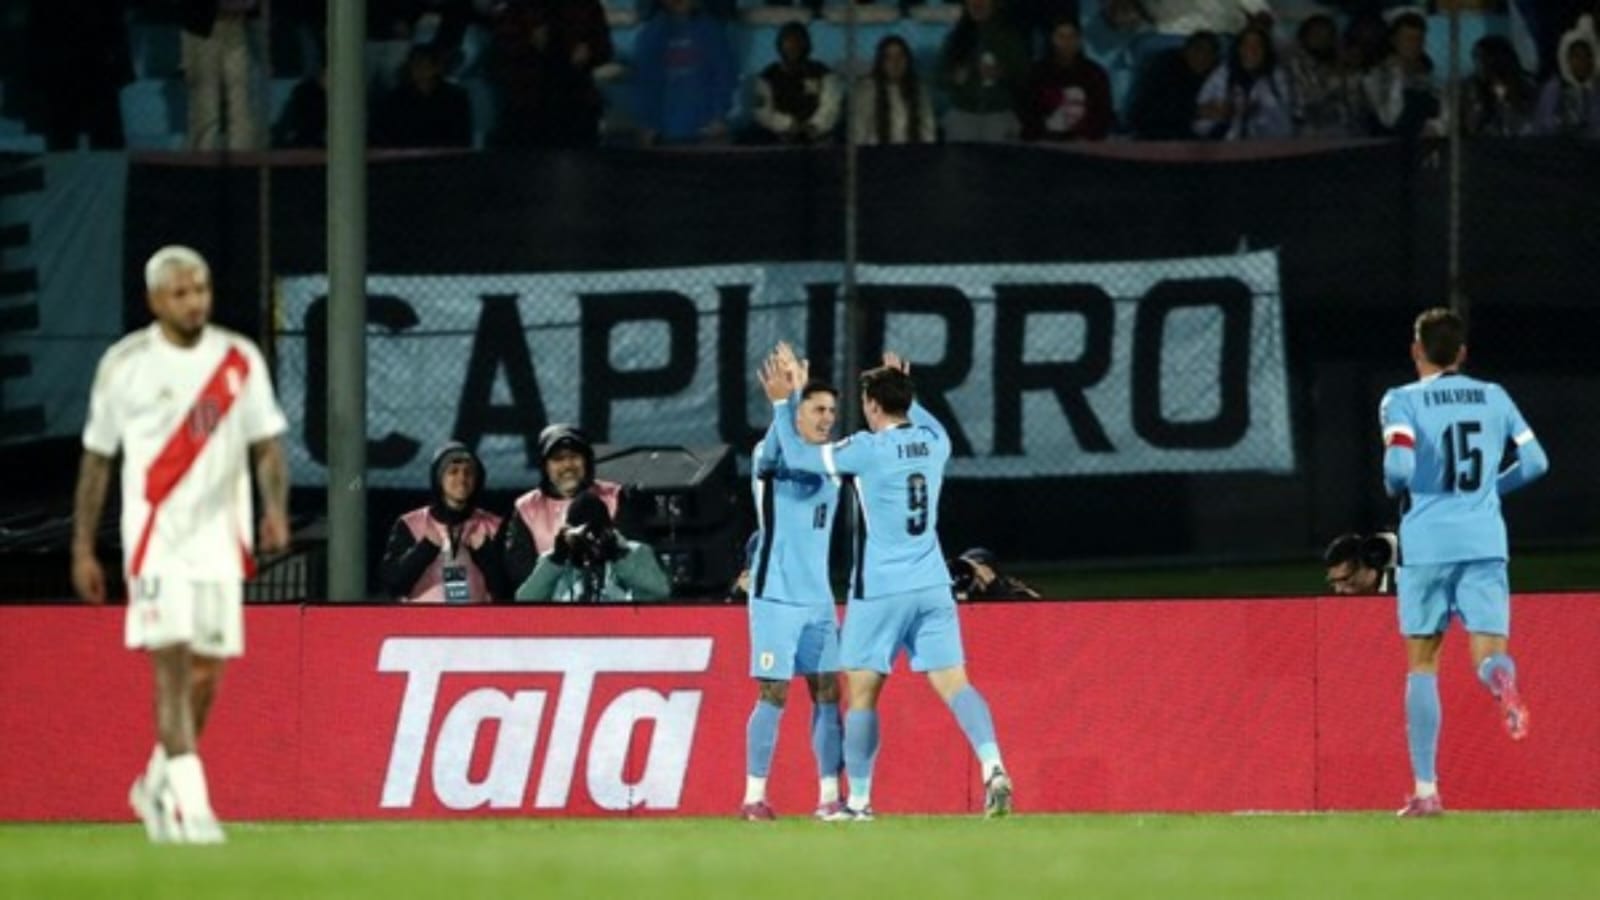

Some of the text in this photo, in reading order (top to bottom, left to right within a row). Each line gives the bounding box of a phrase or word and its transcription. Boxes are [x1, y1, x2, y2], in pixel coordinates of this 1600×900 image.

[303, 276, 1253, 469] CAPURRO
[906, 472, 928, 536] 9
[1443, 421, 1482, 492] 15
[378, 637, 714, 810] TaTa
